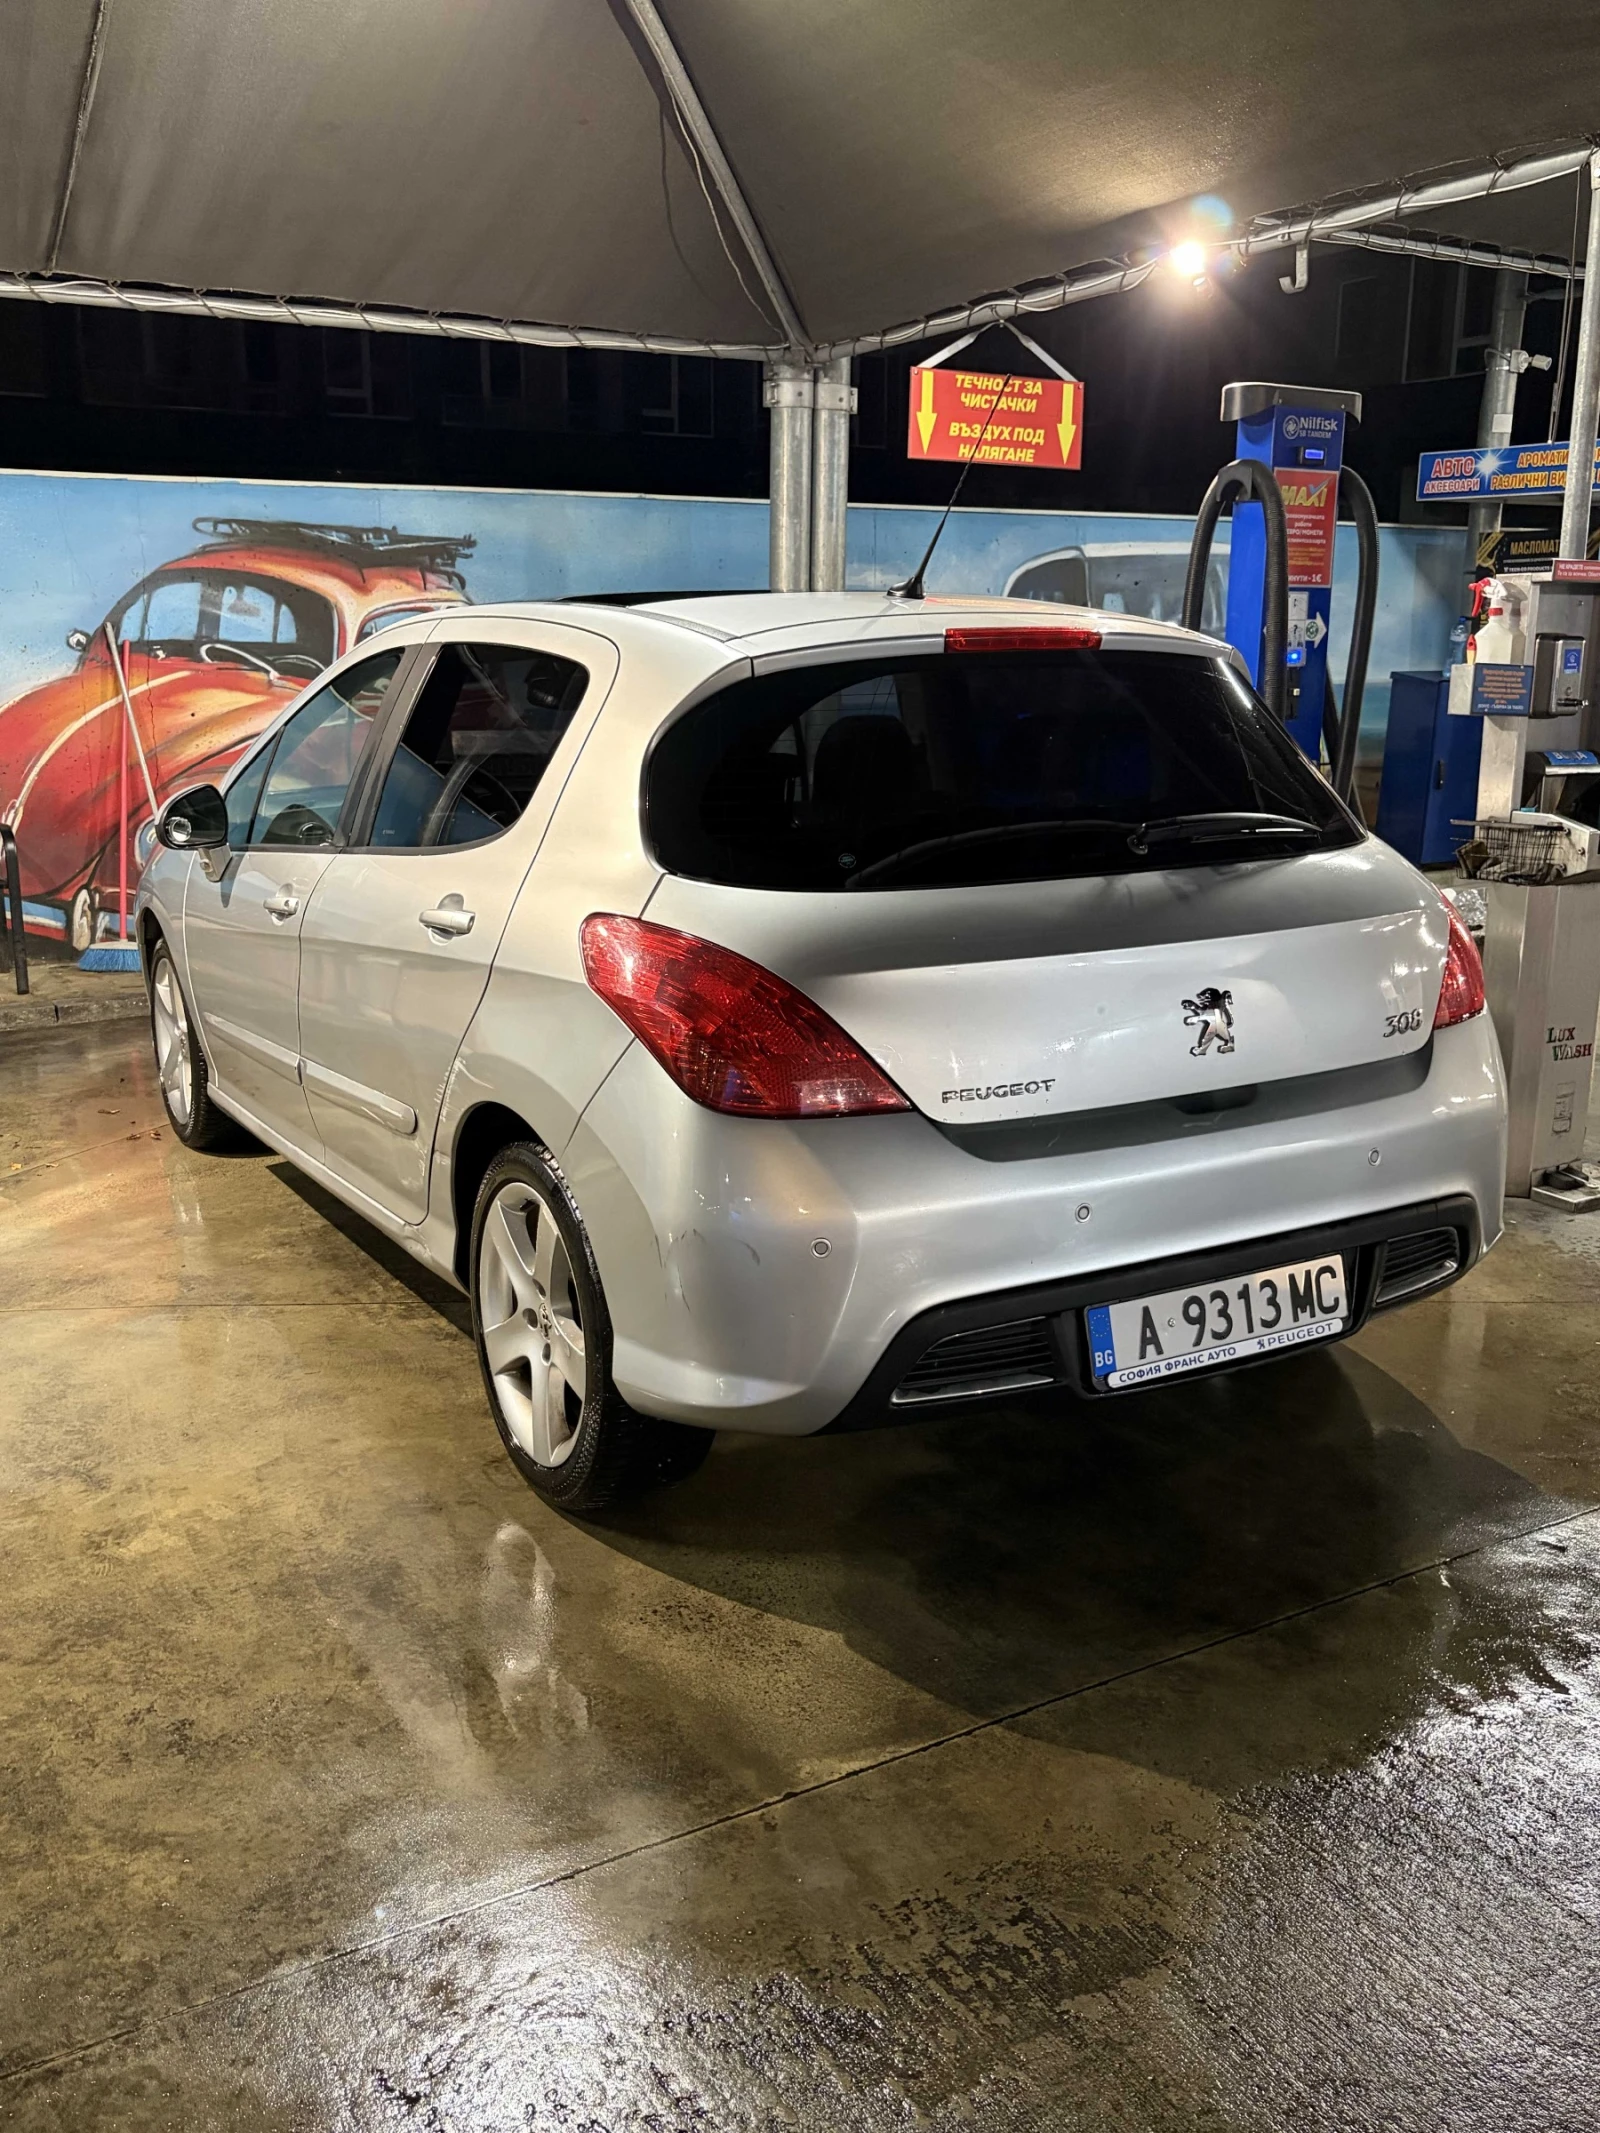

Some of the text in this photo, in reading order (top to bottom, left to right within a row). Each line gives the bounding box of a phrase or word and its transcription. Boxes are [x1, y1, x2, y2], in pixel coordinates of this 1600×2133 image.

[955, 374, 1043, 395] ТЕЧНОСТ ЗА
[960, 392, 1037, 413] ЧИСТАЧКИ
[1300, 416, 1338, 431] Nilfisk
[949, 422, 1045, 446] ВЪЗДУХ ПОД
[958, 443, 1036, 463] НАЛЯГАНЕ
[1517, 449, 1570, 469] АРОМАТИ
[1431, 456, 1476, 479] АВТО
[1423, 477, 1481, 494] АКСЕСОАРИ
[1490, 471, 1550, 490] РАЗЛИЧНИ
[1510, 539, 1560, 555] МАСЛОМАТ
[1383, 1008, 1422, 1038] 308
[1546, 1026, 1576, 1044] LUX
[1552, 1043, 1593, 1061] WASH
[941, 1078, 1056, 1104] PEUGEOT
[1182, 1278, 1282, 1348] 9313
[1267, 1322, 1334, 1348] PEUGEOT
[1094, 1349, 1114, 1368] BG
[1118, 1346, 1237, 1384] СОФИЯ ФРАНС АУТО
